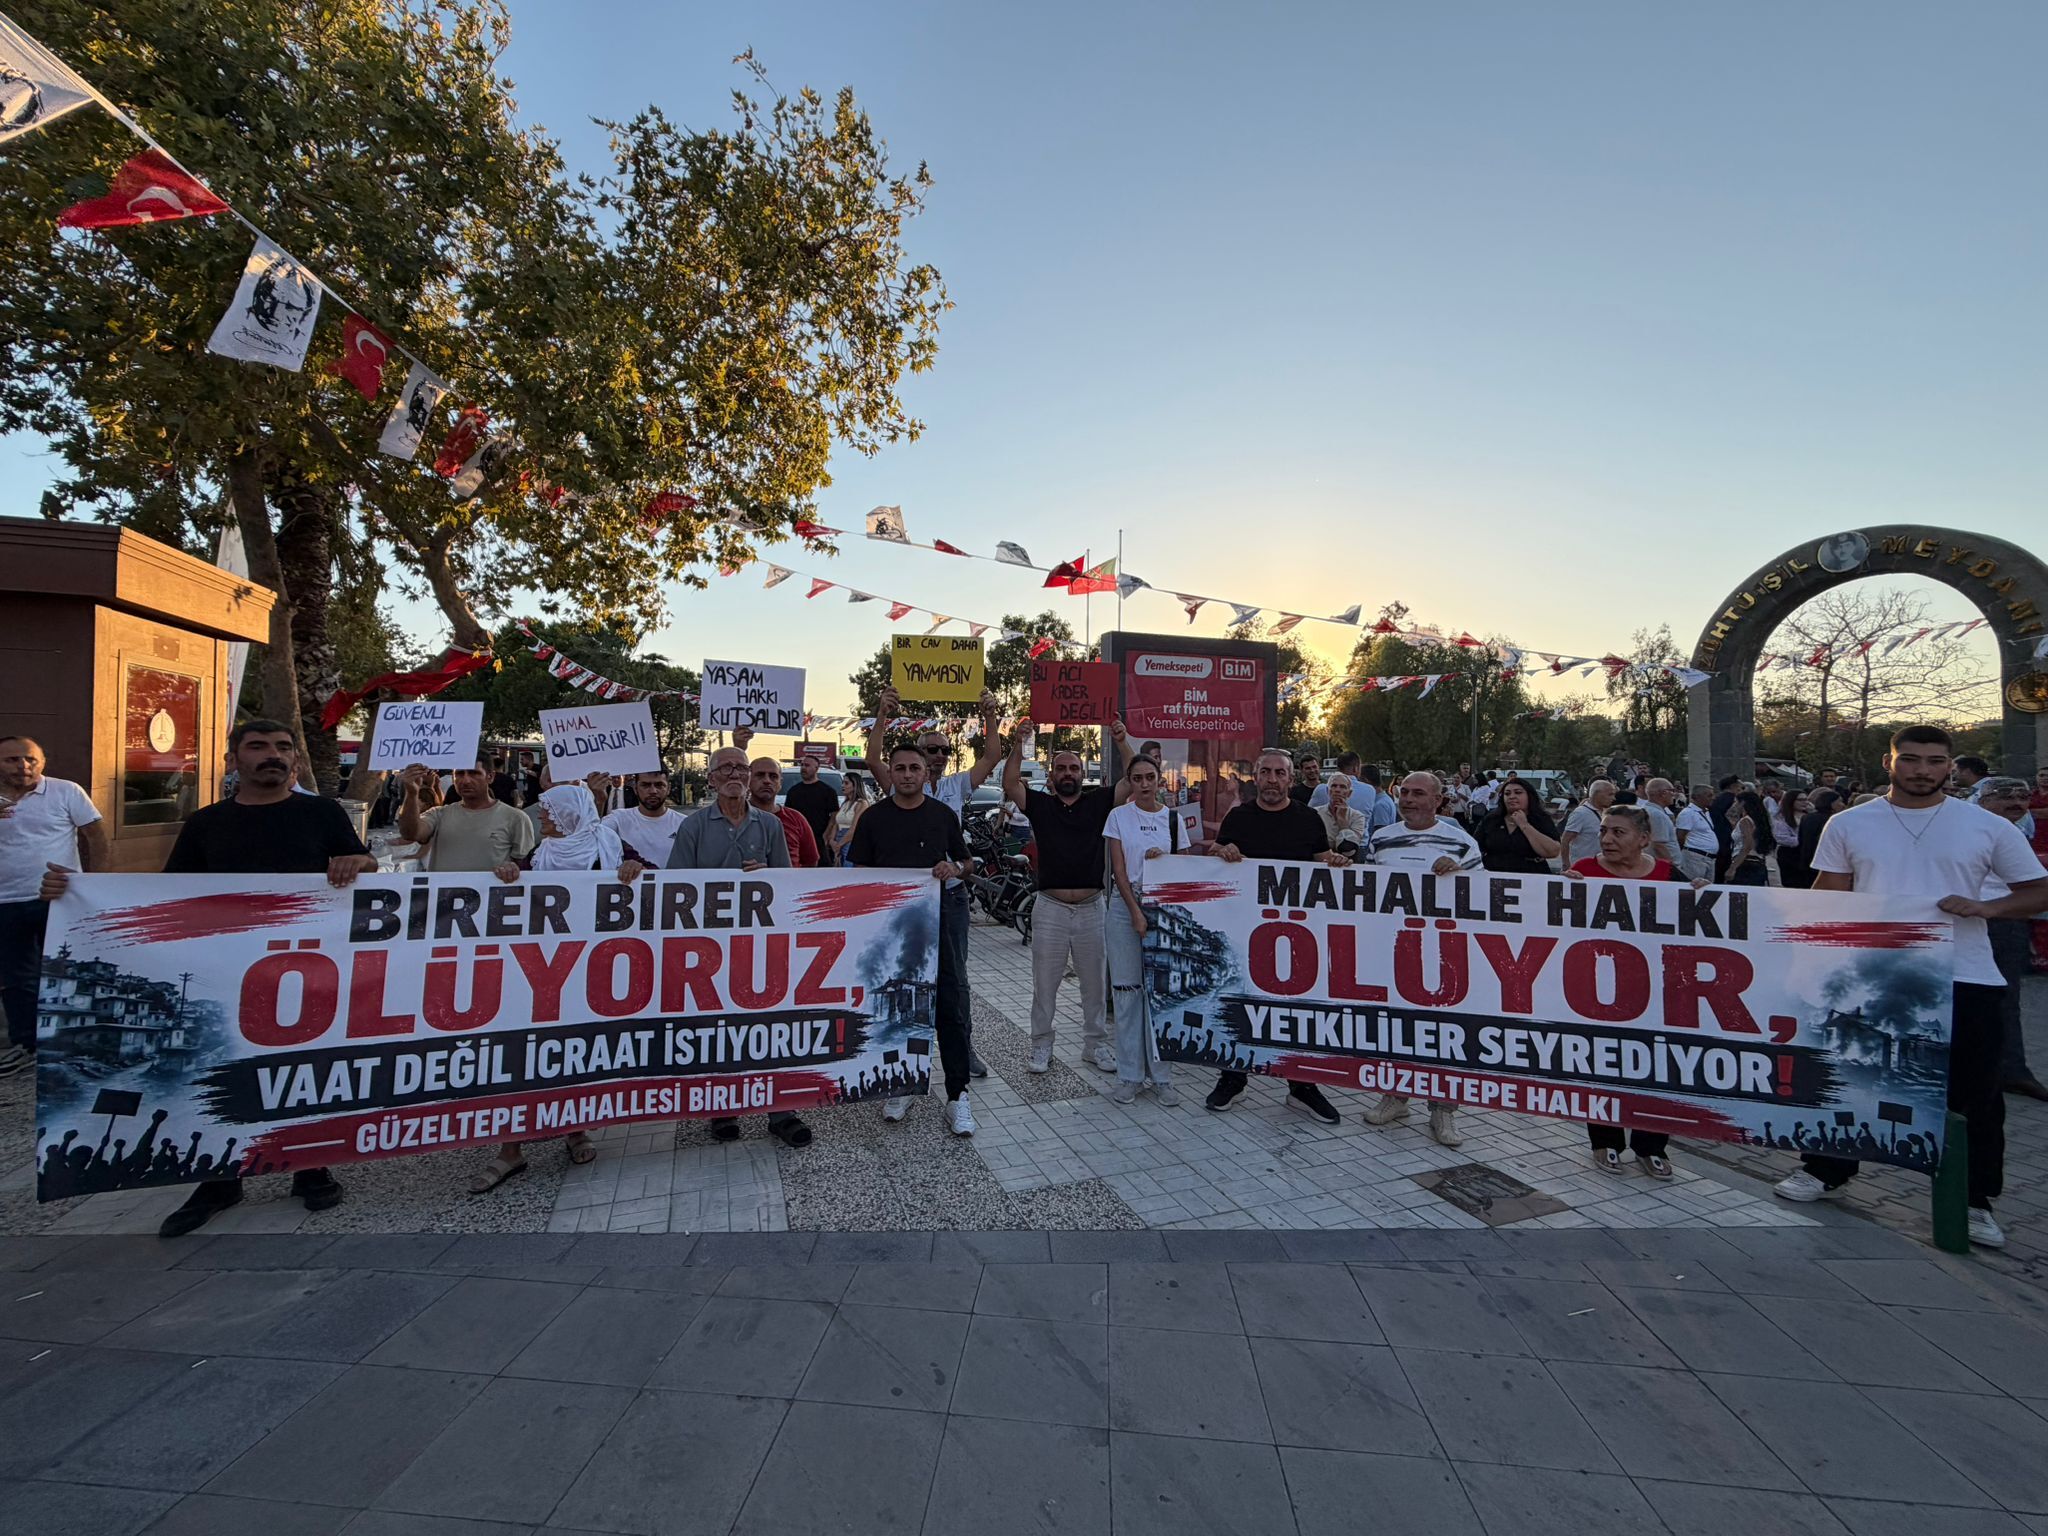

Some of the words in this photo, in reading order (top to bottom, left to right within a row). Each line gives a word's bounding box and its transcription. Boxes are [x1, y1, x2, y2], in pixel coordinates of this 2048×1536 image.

[1881, 535, 2044, 634] MEYDANI
[920, 638, 942, 649] CAN
[951, 639, 979, 651] DAHA
[705, 664, 764, 688] YAŞAM
[902, 661, 973, 685] YANMASIN
[1033, 662, 1048, 682] BU
[1058, 665, 1083, 682] ACI
[1144, 658, 1205, 674] Yemeksepeti
[1224, 659, 1252, 677] BİM
[737, 687, 778, 704] HAKKI
[1050, 684, 1090, 700] KADER
[1183, 687, 1209, 702] BİM
[709, 703, 801, 731] KUTSALDIR
[1162, 703, 1182, 715] raf
[1183, 703, 1231, 718] fiyatına
[410, 723, 453, 738] YAŞAM
[547, 715, 598, 737] İHMAL
[348, 876, 571, 943] BİRER
[594, 873, 775, 933] BİRER
[1257, 865, 1523, 924] MAHALLE
[1546, 880, 1749, 941] HALKI
[1248, 908, 1798, 1044] ÖLÜYOR,
[238, 930, 865, 1047] ÖLÜYORUZ,
[1243, 1003, 1468, 1062] YETKİLİLER
[1478, 1025, 1794, 1097] SEYREDİYOR!
[256, 1056, 382, 1110] VAAT
[393, 1038, 512, 1096] DEĞİL
[524, 1028, 655, 1082] İCRAAT
[663, 1017, 846, 1066] İSTİYORUZ!
[1358, 1061, 1518, 1104] GÜZELTEPE
[1526, 1085, 1621, 1123] HALKI
[355, 1104, 528, 1154] GÜZELTEPE
[535, 1082, 681, 1131] MAHALLESİ
[688, 1076, 774, 1113] BİRLİĞİ
